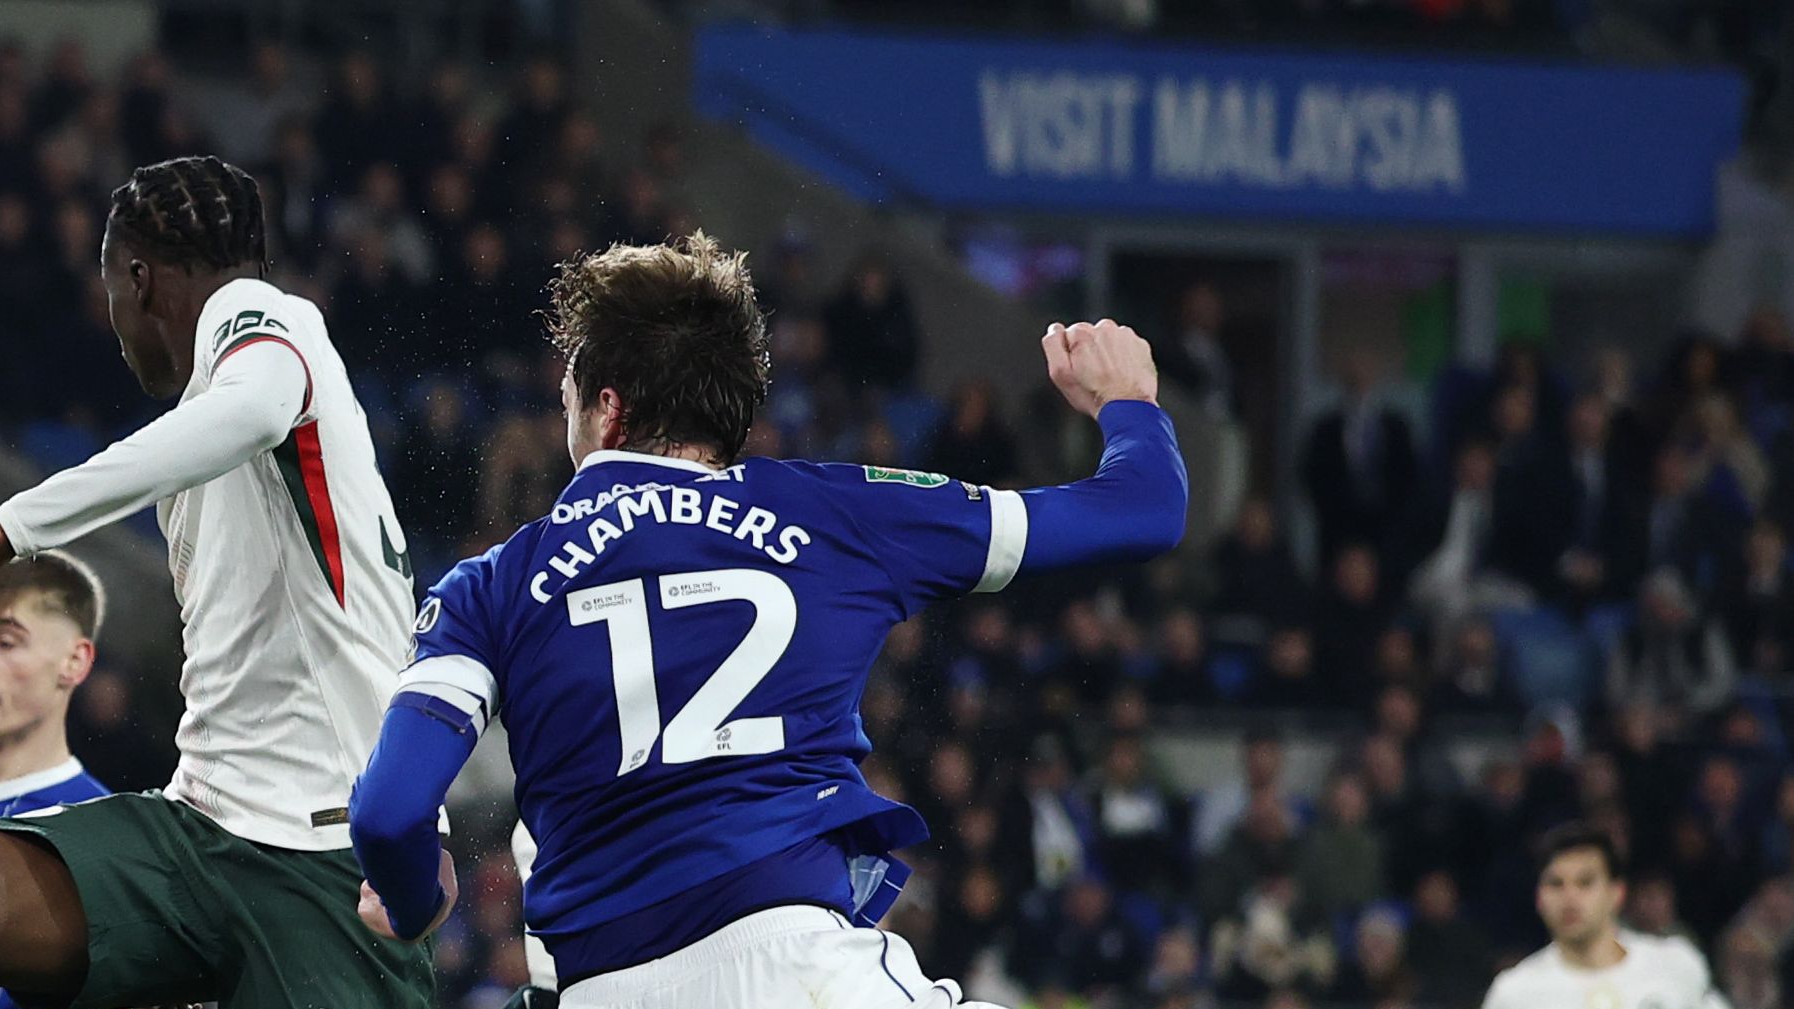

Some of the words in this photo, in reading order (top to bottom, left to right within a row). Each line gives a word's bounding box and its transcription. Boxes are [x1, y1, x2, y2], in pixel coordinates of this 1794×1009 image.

[979, 72, 1137, 177] VISIT
[1152, 78, 1464, 192] MALAYSIA
[530, 488, 811, 604] CHAMBERS
[551, 481, 671, 524] DRA
[694, 463, 747, 482] ET
[566, 568, 797, 777] 12
[717, 743, 732, 751] EFL
